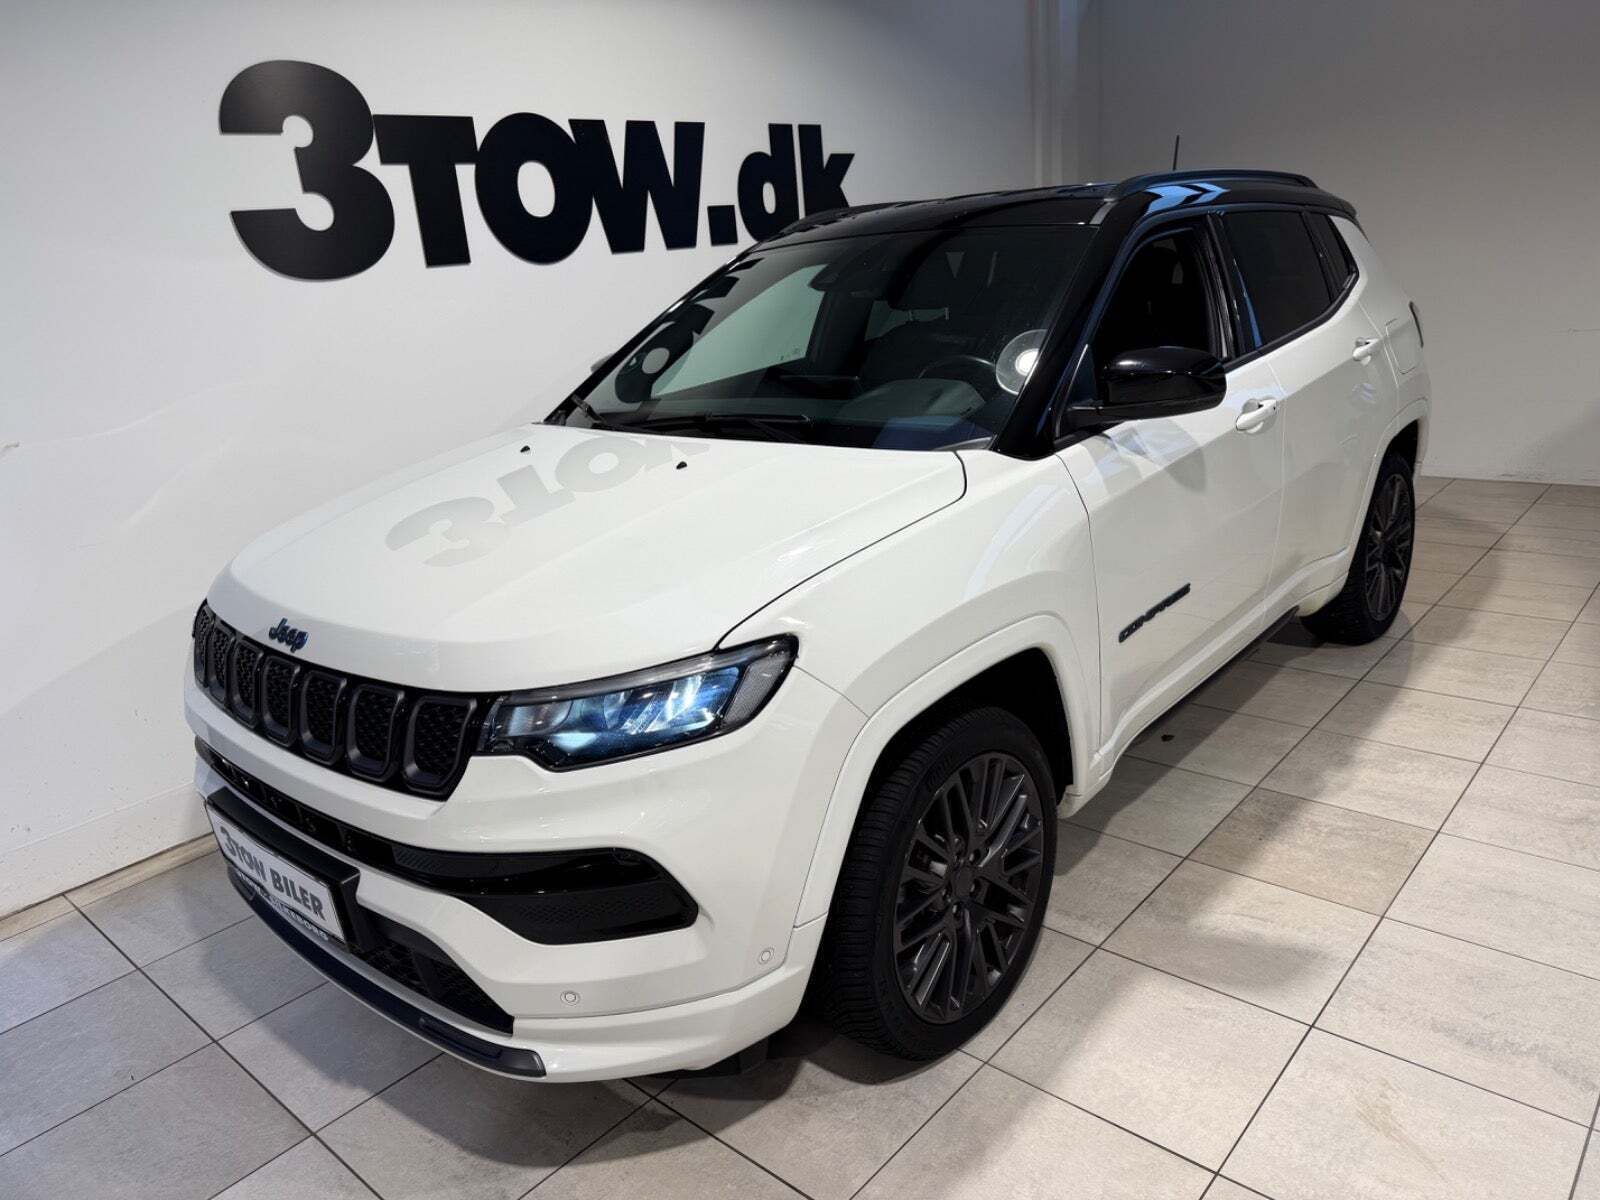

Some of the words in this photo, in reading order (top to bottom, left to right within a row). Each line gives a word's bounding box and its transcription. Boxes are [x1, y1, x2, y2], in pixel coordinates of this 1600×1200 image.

[219, 59, 855, 281] 3TOW.dk
[268, 617, 308, 653] Jeep
[269, 867, 327, 921] BILER
